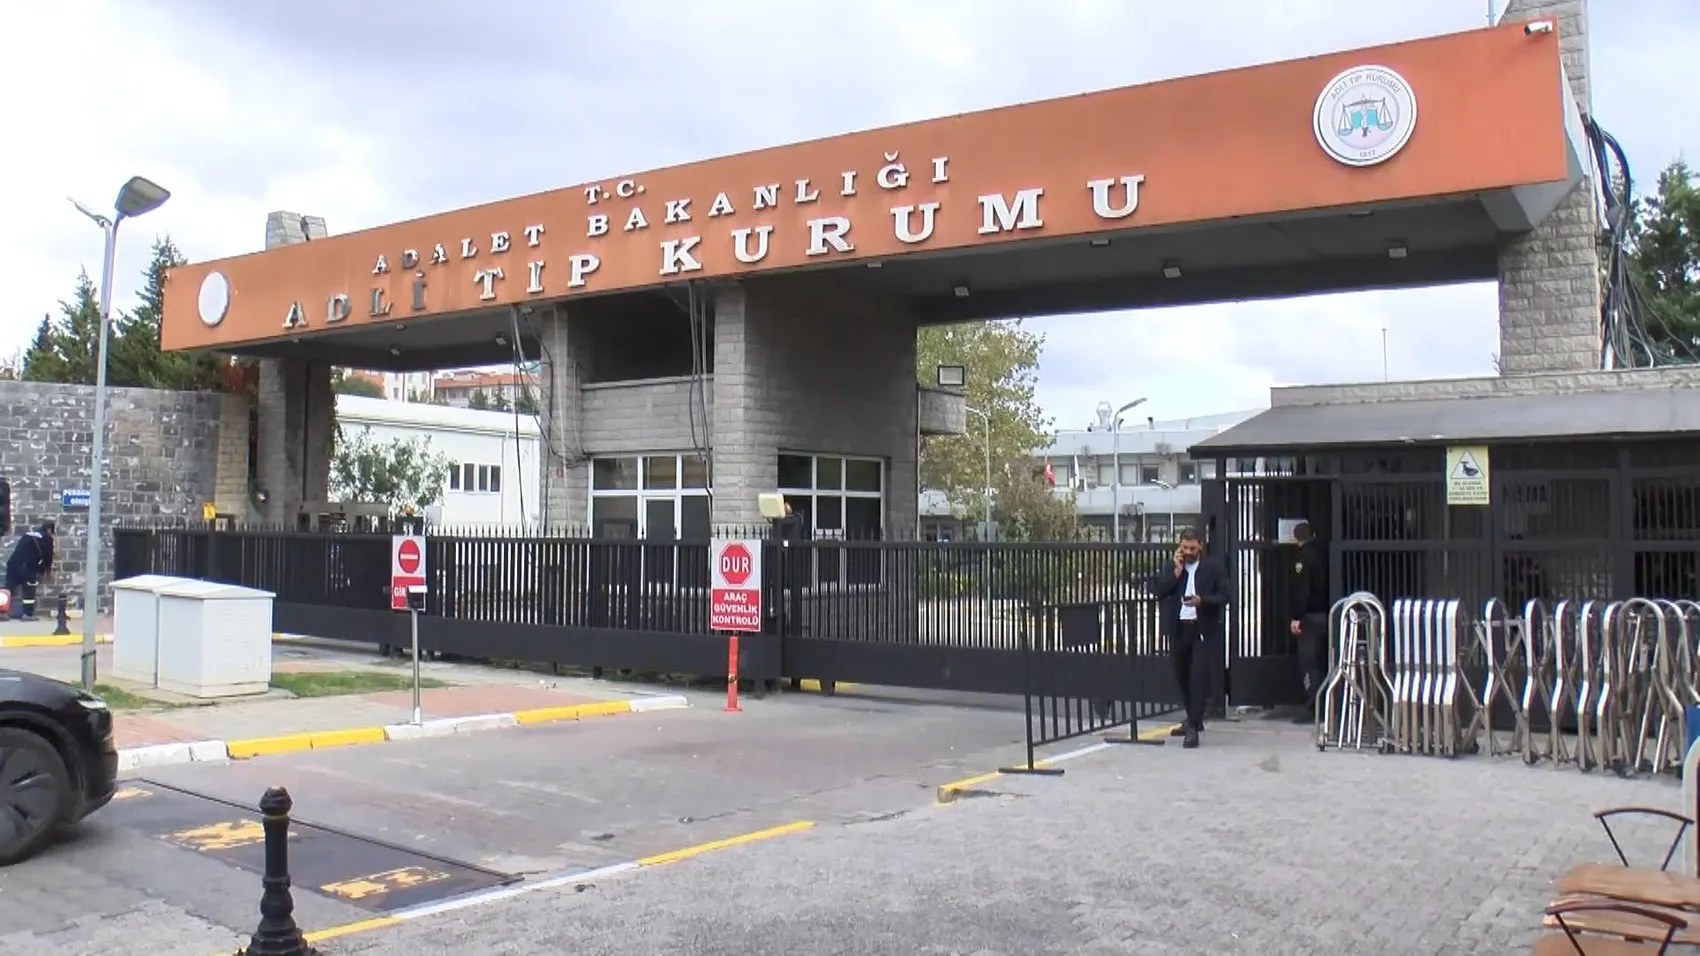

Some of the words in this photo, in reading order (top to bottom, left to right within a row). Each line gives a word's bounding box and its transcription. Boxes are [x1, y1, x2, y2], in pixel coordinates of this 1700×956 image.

[584, 180, 646, 205] T.C.
[372, 224, 545, 275] ADALET
[586, 150, 949, 238] BAKANLIĞI
[282, 269, 427, 330] ADLİ
[473, 254, 601, 302] TIP
[658, 174, 1146, 277] KURUMU
[722, 556, 750, 574] DUR
[724, 592, 748, 604] ARAÇ
[714, 603, 758, 614] GÜVENLİK
[712, 614, 759, 626] KONTROLÜ
